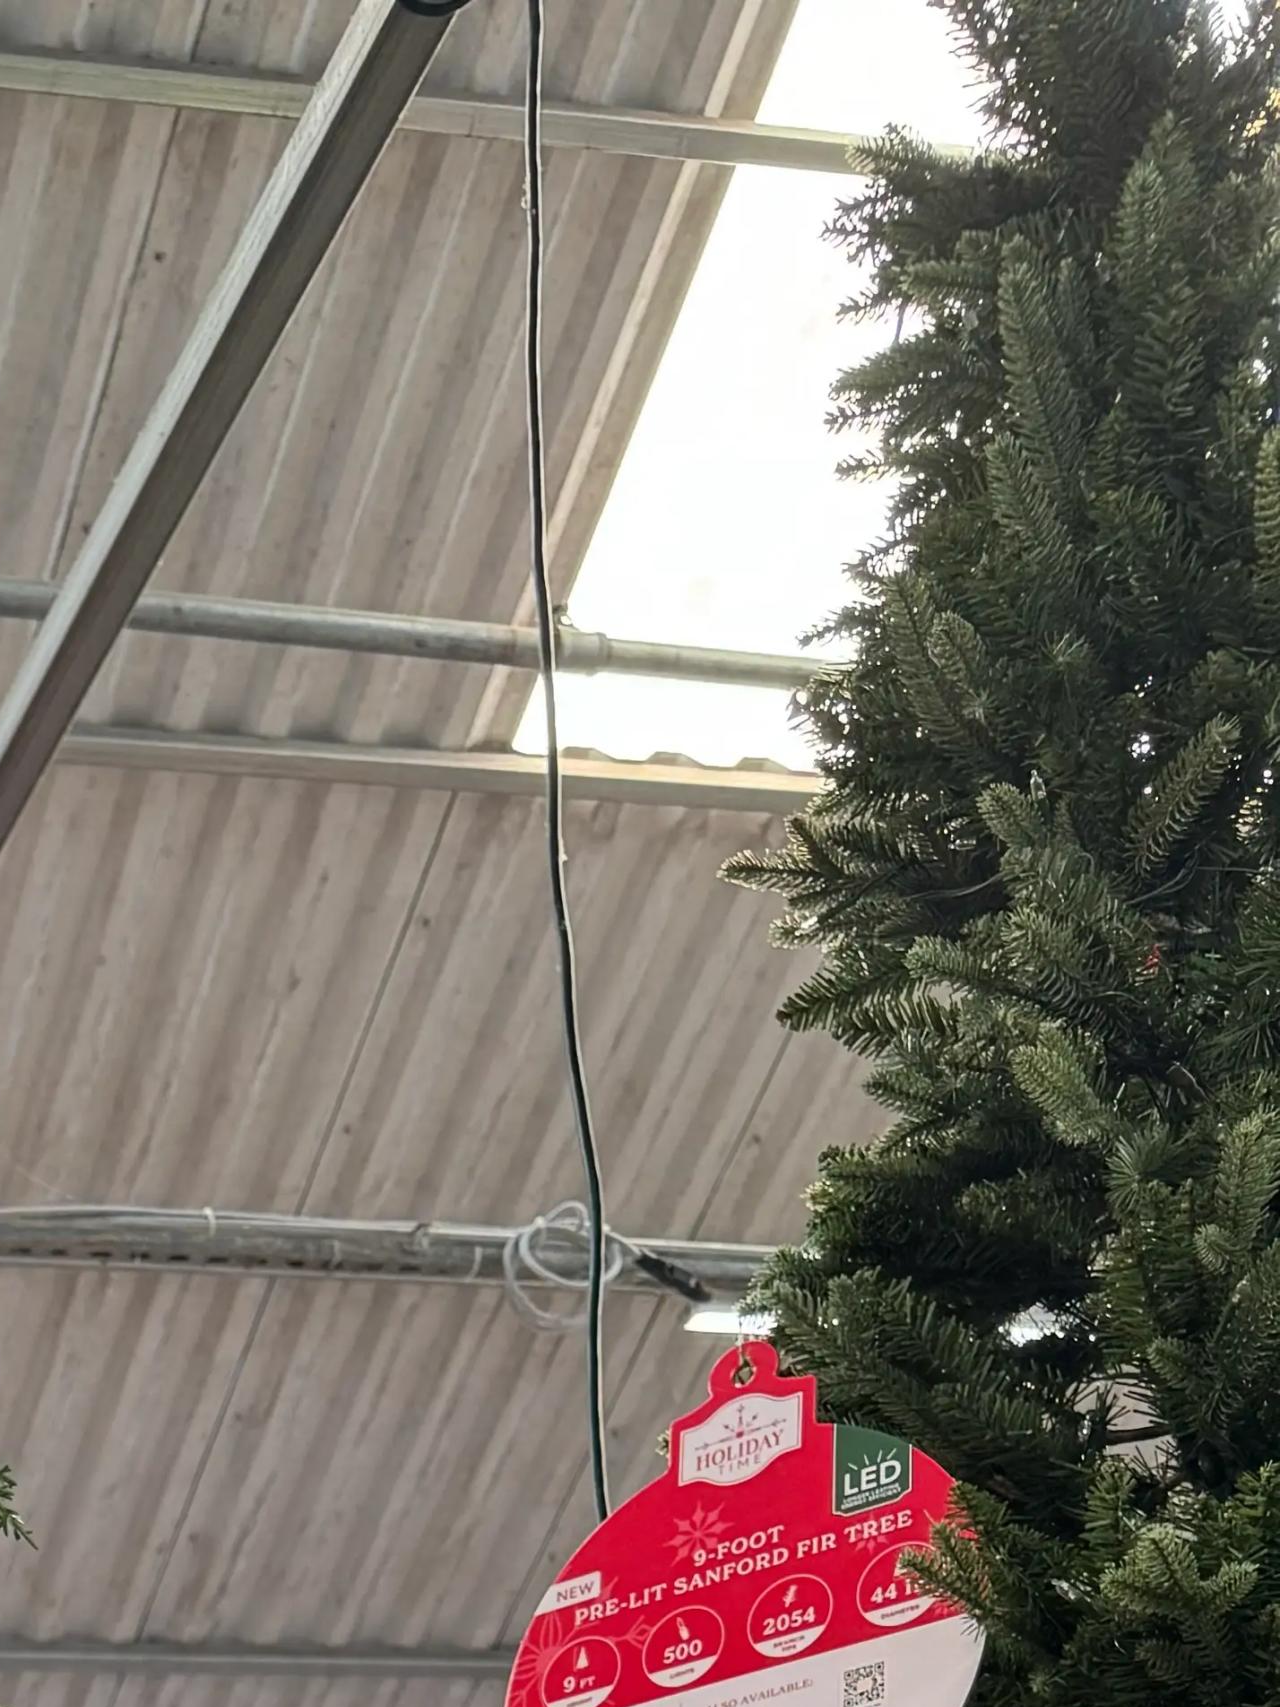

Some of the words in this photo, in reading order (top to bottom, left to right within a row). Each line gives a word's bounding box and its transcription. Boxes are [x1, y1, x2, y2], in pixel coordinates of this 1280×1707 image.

[695, 1431, 783, 1472] HOLIDAY
[719, 1455, 761, 1475] TIME
[844, 1460, 902, 1496] LED
[694, 1525, 785, 1566] 9-FOOT
[574, 1583, 668, 1627] PRE-LIT
[673, 1548, 789, 1595] SANFORD
[796, 1533, 838, 1559] FIR
[843, 1509, 914, 1543] TREE
[556, 1581, 595, 1603] NEW
[870, 1583, 897, 1604] 44
[762, 1606, 816, 1636] 2054
[663, 1640, 703, 1664] 500
[563, 1676, 576, 1693] 9
[579, 1675, 596, 1689] FT
